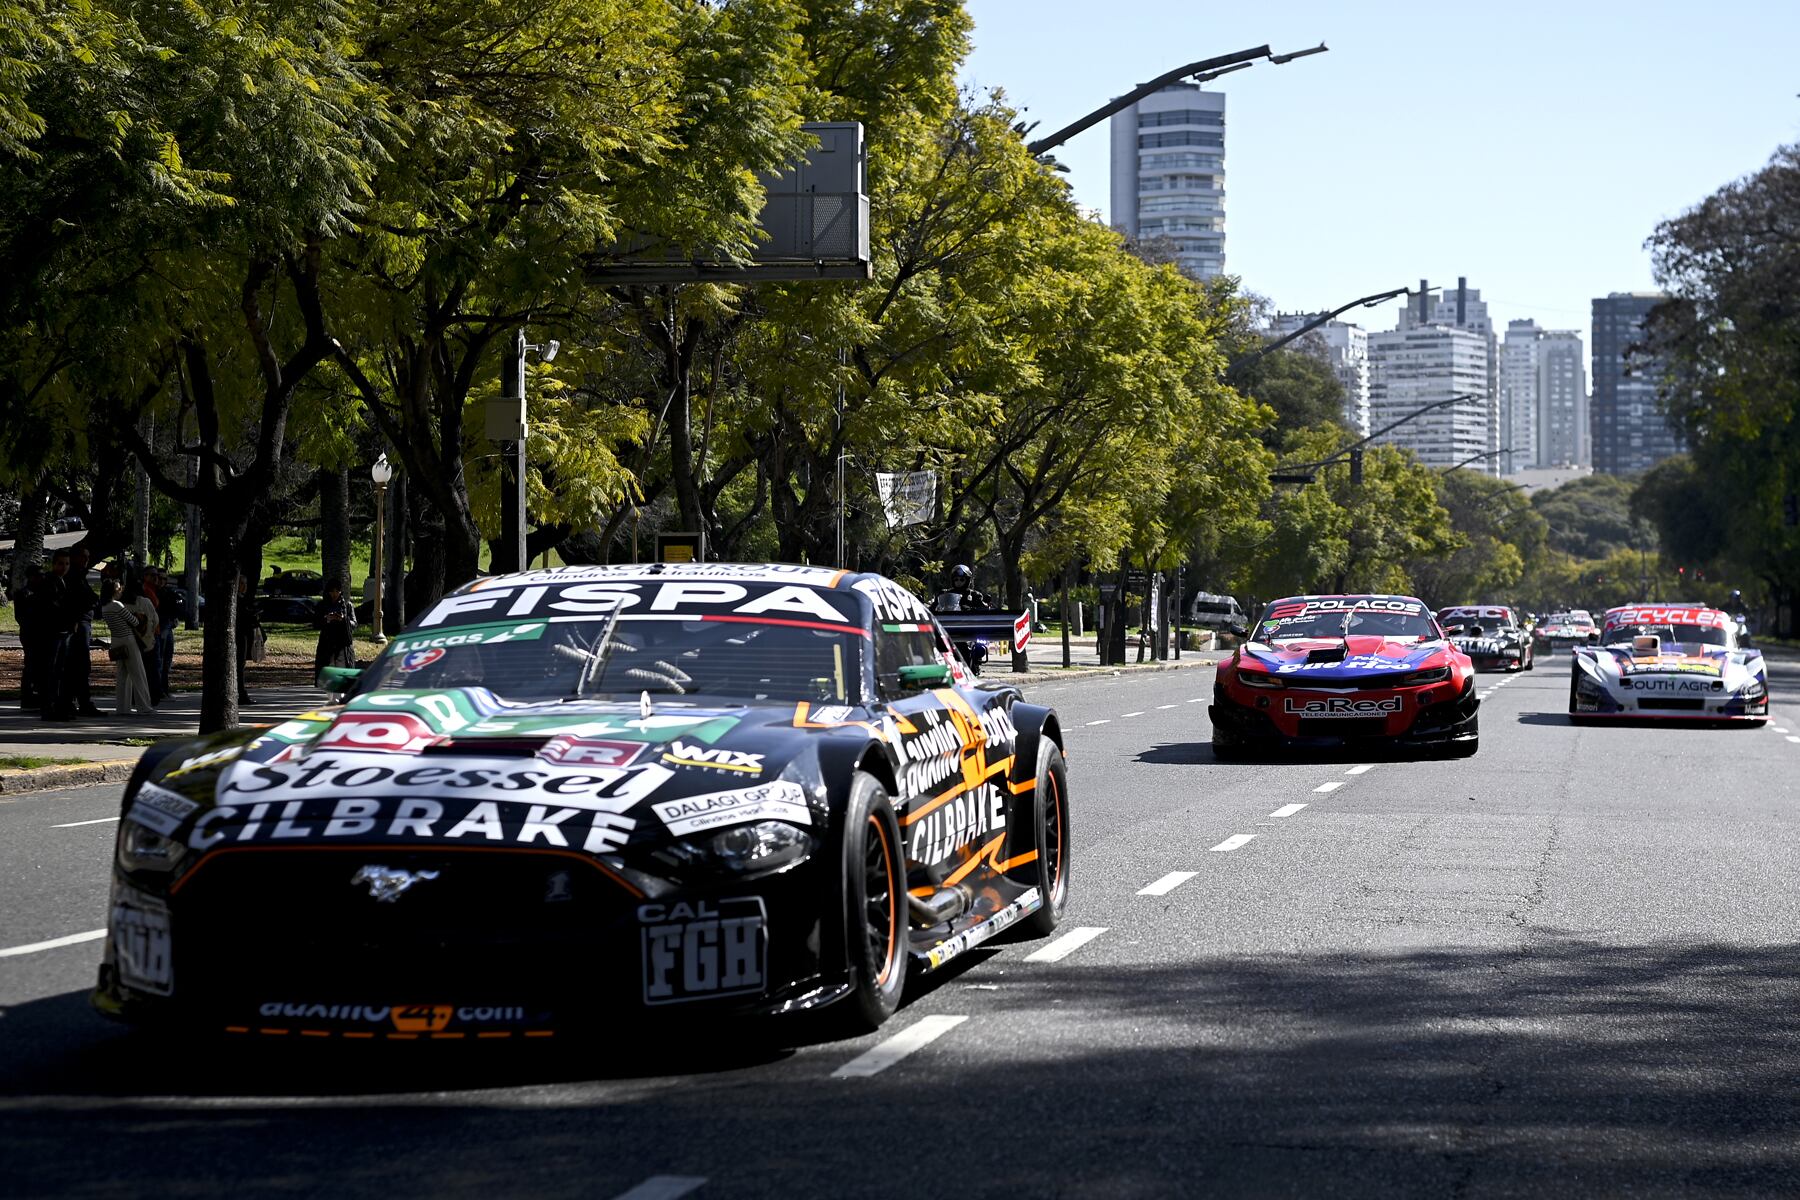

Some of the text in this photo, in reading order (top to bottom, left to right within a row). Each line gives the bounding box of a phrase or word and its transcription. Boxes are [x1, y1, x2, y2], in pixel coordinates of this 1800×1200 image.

[530, 569, 767, 582] Cilindros Hdráulicos
[418, 582, 849, 627] FISPA
[868, 577, 930, 622] FISPA
[1606, 610, 1729, 625] RECYCLER
[393, 633, 484, 653] Lucas
[1624, 680, 1674, 690] SOUTH
[1285, 697, 1402, 713] LaRed
[672, 741, 766, 768] WIX
[222, 757, 649, 798] Stoessel
[664, 796, 739, 819] DALAGI
[188, 798, 637, 853] CILBRAKE
[912, 783, 1006, 866] CILBRAKE
[637, 900, 719, 923] CAL
[649, 916, 762, 997] FGH
[456, 1004, 524, 1022] com
